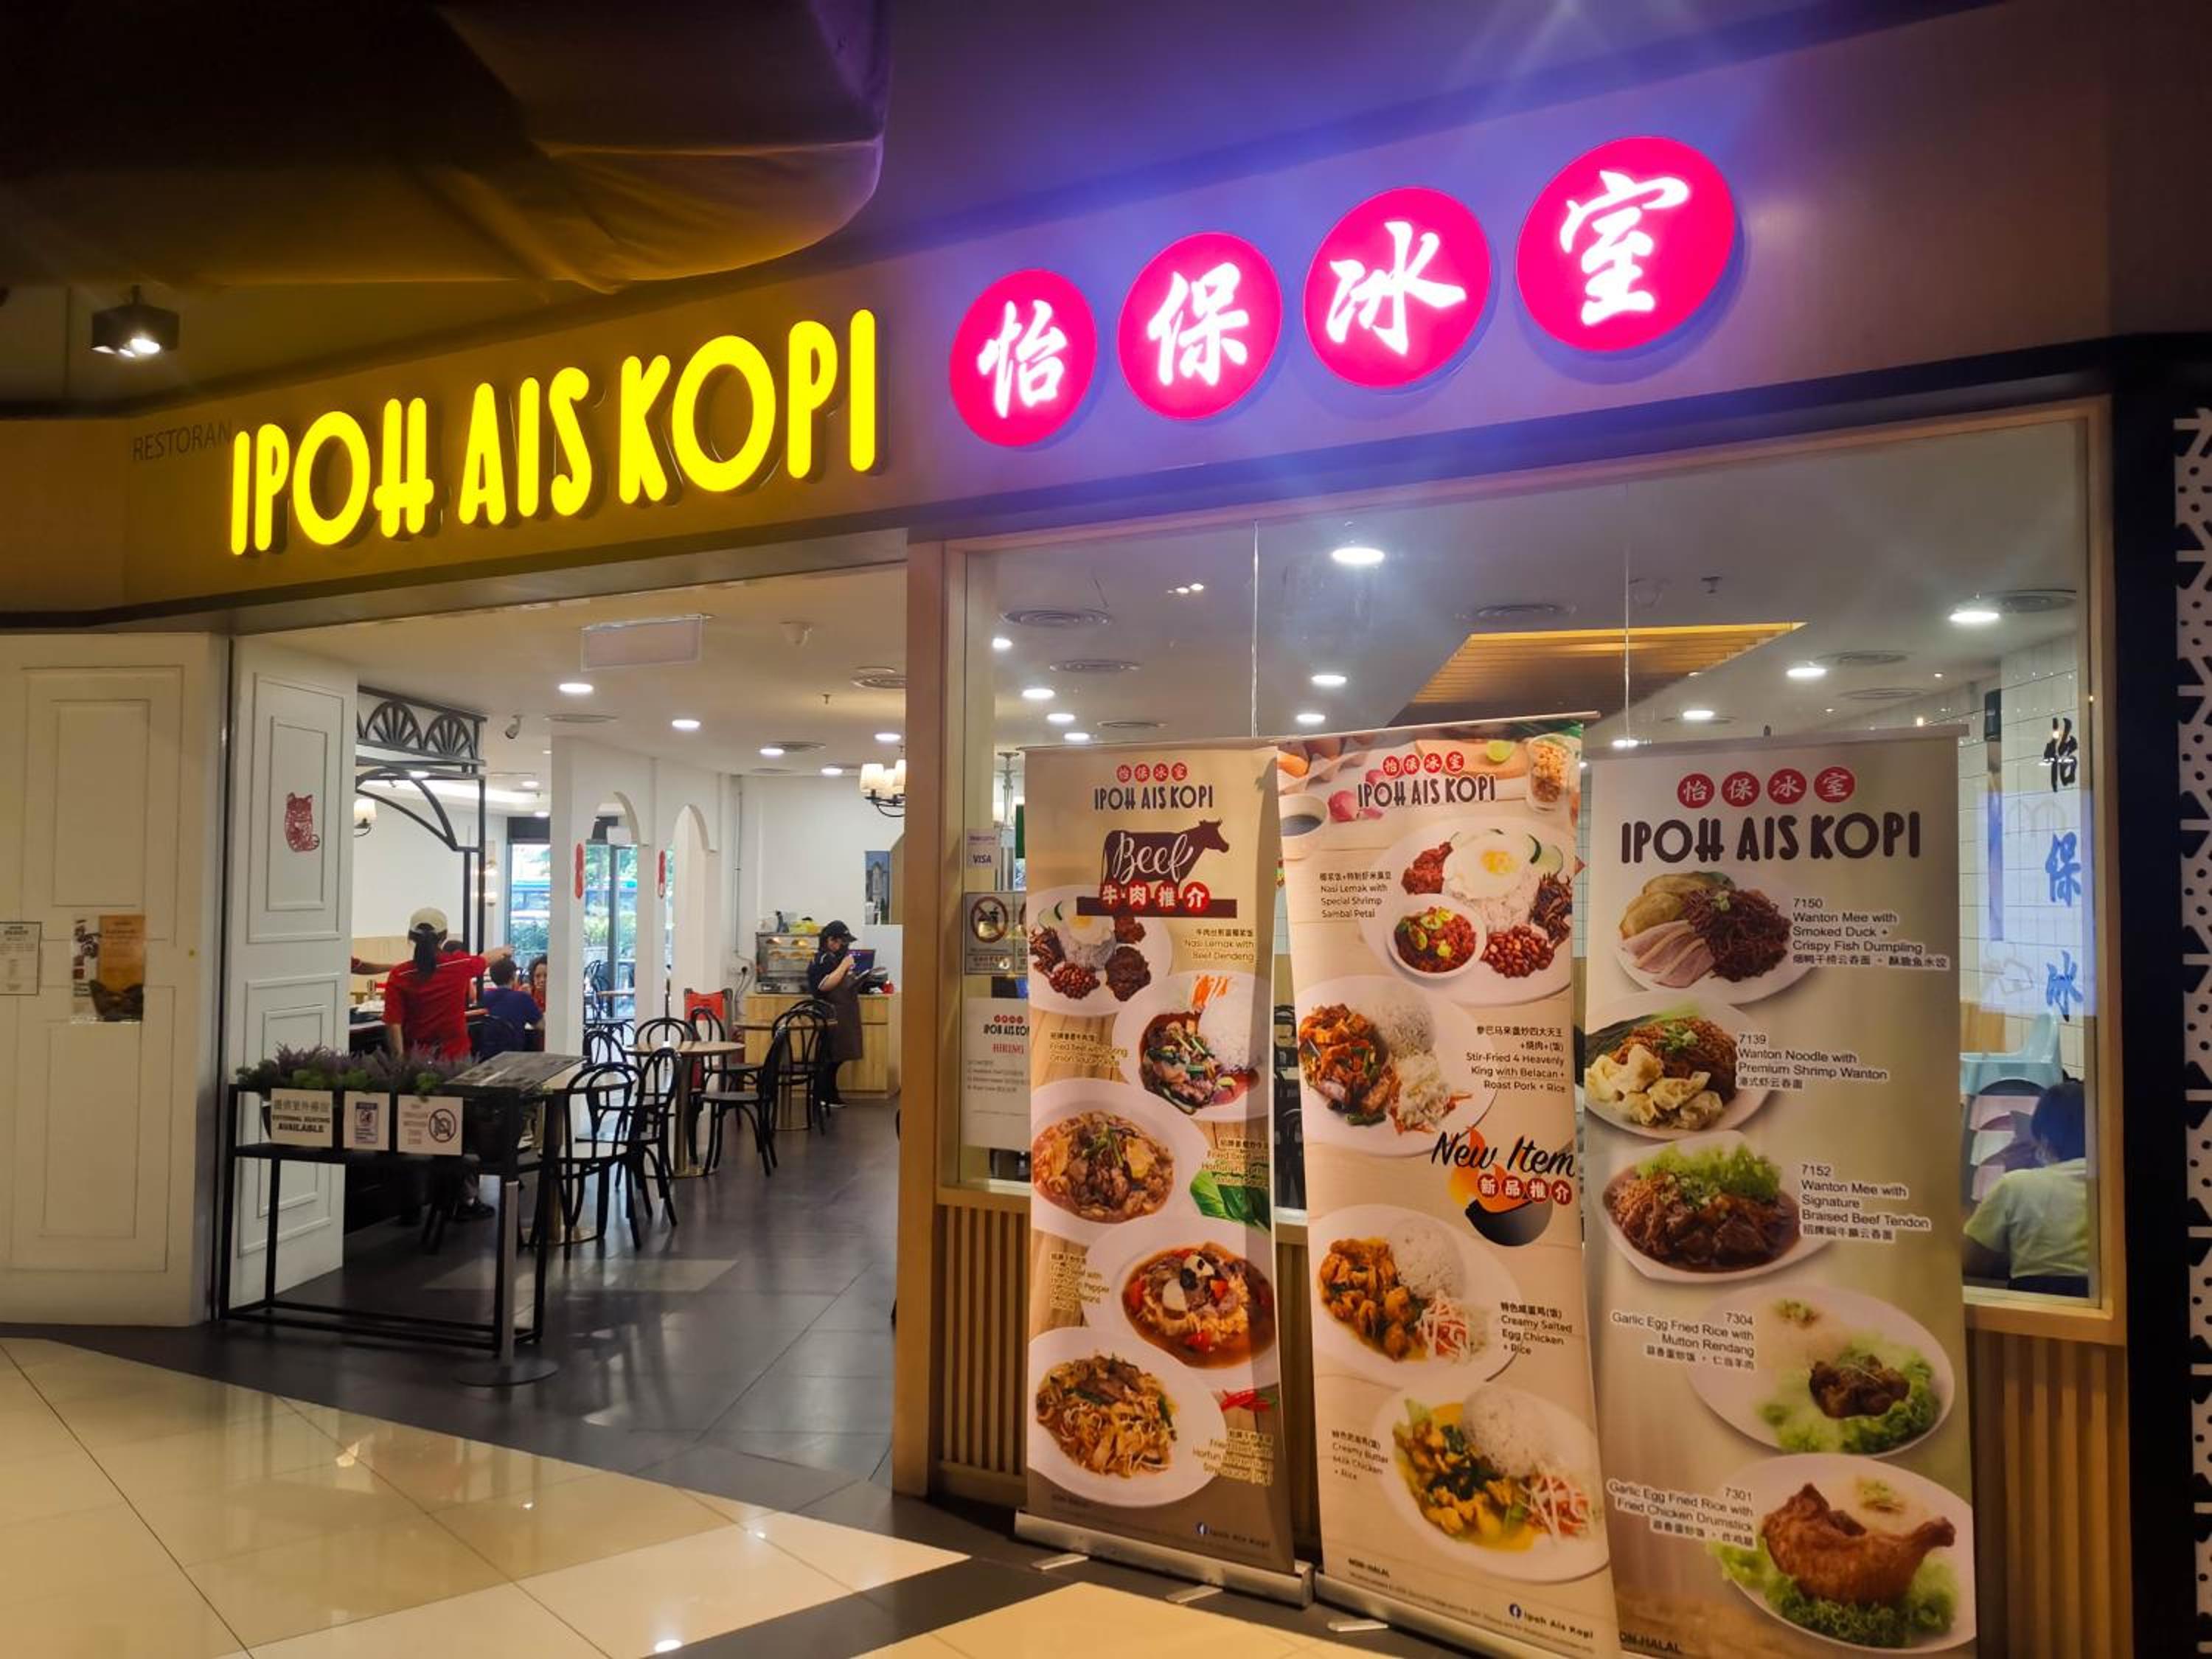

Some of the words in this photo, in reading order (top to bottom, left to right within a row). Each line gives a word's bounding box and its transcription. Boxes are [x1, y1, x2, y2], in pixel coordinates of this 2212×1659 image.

[976, 171, 1691, 418] 怡保冰室
[132, 419, 232, 461] RESTORAN
[232, 398, 434, 555] IPOH
[459, 367, 592, 526] AIS
[619, 309, 876, 504] KOPI
[1385, 754, 1463, 773] 怡保冰室
[1357, 781, 1405, 807] IPOH
[1411, 778, 1439, 805] AIS
[1445, 776, 1495, 803] KOPI
[1682, 772, 1848, 803] 怡保冰室
[1095, 786, 1135, 810] IPOH
[1141, 785, 1166, 810] AIS
[1170, 785, 1212, 808] KOPI
[1621, 818, 1724, 863] IPOH
[1736, 815, 1799, 861] AIS
[1811, 812, 1921, 859] KOPI
[973, 855, 992, 863] VISA
[1113, 832, 1194, 885] Beef
[1321, 885, 1338, 893] Nasi
[1340, 884, 1368, 893] Lemak
[1369, 884, 1388, 892] with
[1321, 897, 1350, 906] Special
[1352, 897, 1382, 906] Shrimp
[1793, 897, 1823, 908] 7150
[1322, 909, 1352, 918] Sambal
[1354, 909, 1375, 918] Petai
[1793, 912, 1838, 923] Wanton
[1842, 913, 1869, 923] Mee
[1872, 912, 1897, 923] with
[1793, 926, 1841, 938] Smoked
[1845, 927, 1876, 938] Duck
[1237, 940, 1254, 948] with
[1793, 941, 1830, 953] Crispy
[1834, 941, 1862, 951] Fish
[1863, 942, 1923, 955] Dumpling
[1739, 1034, 1767, 1045] 7139
[1466, 1052, 1511, 1063] Stir-Fried
[1512, 1054, 1520, 1062] 4
[1522, 1055, 1565, 1068] Heavenly
[1738, 1048, 1782, 1060] Wanton
[1785, 1049, 1829, 1063] Noodle
[1832, 1052, 1857, 1063] with
[1471, 1066, 1494, 1077] King
[1496, 1067, 1518, 1077] with
[1520, 1068, 1559, 1078] Belacan
[1738, 1062, 1791, 1075] Premium
[1793, 1064, 1837, 1079] Shrimp
[1840, 1067, 1888, 1080] Wanton
[1484, 1080, 1512, 1090] Roast
[1513, 1082, 1537, 1091] Pork
[1546, 1083, 1565, 1093] Rice
[279, 1124, 324, 1133] AVAILABLE
[1431, 1131, 1498, 1169] New
[1507, 1135, 1576, 1178] Item
[1802, 1165, 1831, 1177] 7152
[1479, 1175, 1571, 1203] 新品推介
[1801, 1180, 1848, 1193] Wanton
[1851, 1184, 1879, 1195] Mee
[1882, 1186, 1907, 1197] with
[1802, 1194, 1860, 1210] Signature
[1802, 1210, 1848, 1222] Braised
[1851, 1212, 1883, 1225] Beef
[1885, 1214, 1930, 1228] Tendon
[1500, 1315, 1539, 1329] Creamy
[1541, 1321, 1573, 1333] Salted
[1612, 1312, 1644, 1326] Garlic
[1646, 1318, 1669, 1332] Egg
[1671, 1321, 1699, 1335] Fried
[1702, 1324, 1728, 1339] Rice
[1731, 1329, 1754, 1341] with
[1725, 1312, 1753, 1326] 7304
[1502, 1329, 1521, 1342] Egg
[1523, 1332, 1564, 1346] Chicken
[1661, 1333, 1700, 1350] Mutton
[1702, 1338, 1755, 1357] Rendang
[1609, 1482, 1641, 1498] Garlic
[1644, 1488, 1666, 1503] Egg
[1669, 1493, 1698, 1508] Fried
[1702, 1499, 1727, 1512] Rice
[1730, 1503, 1753, 1517] with
[1725, 1487, 1753, 1501] 7301
[1616, 1498, 1644, 1514] Fried
[1647, 1503, 1694, 1522] Chicken
[1697, 1512, 1753, 1531] Drumstick
[1523, 1610, 1547, 1622] Ipoh
[1550, 1618, 1567, 1629] Ais
[1619, 1630, 1685, 1655] ON-HALAL
